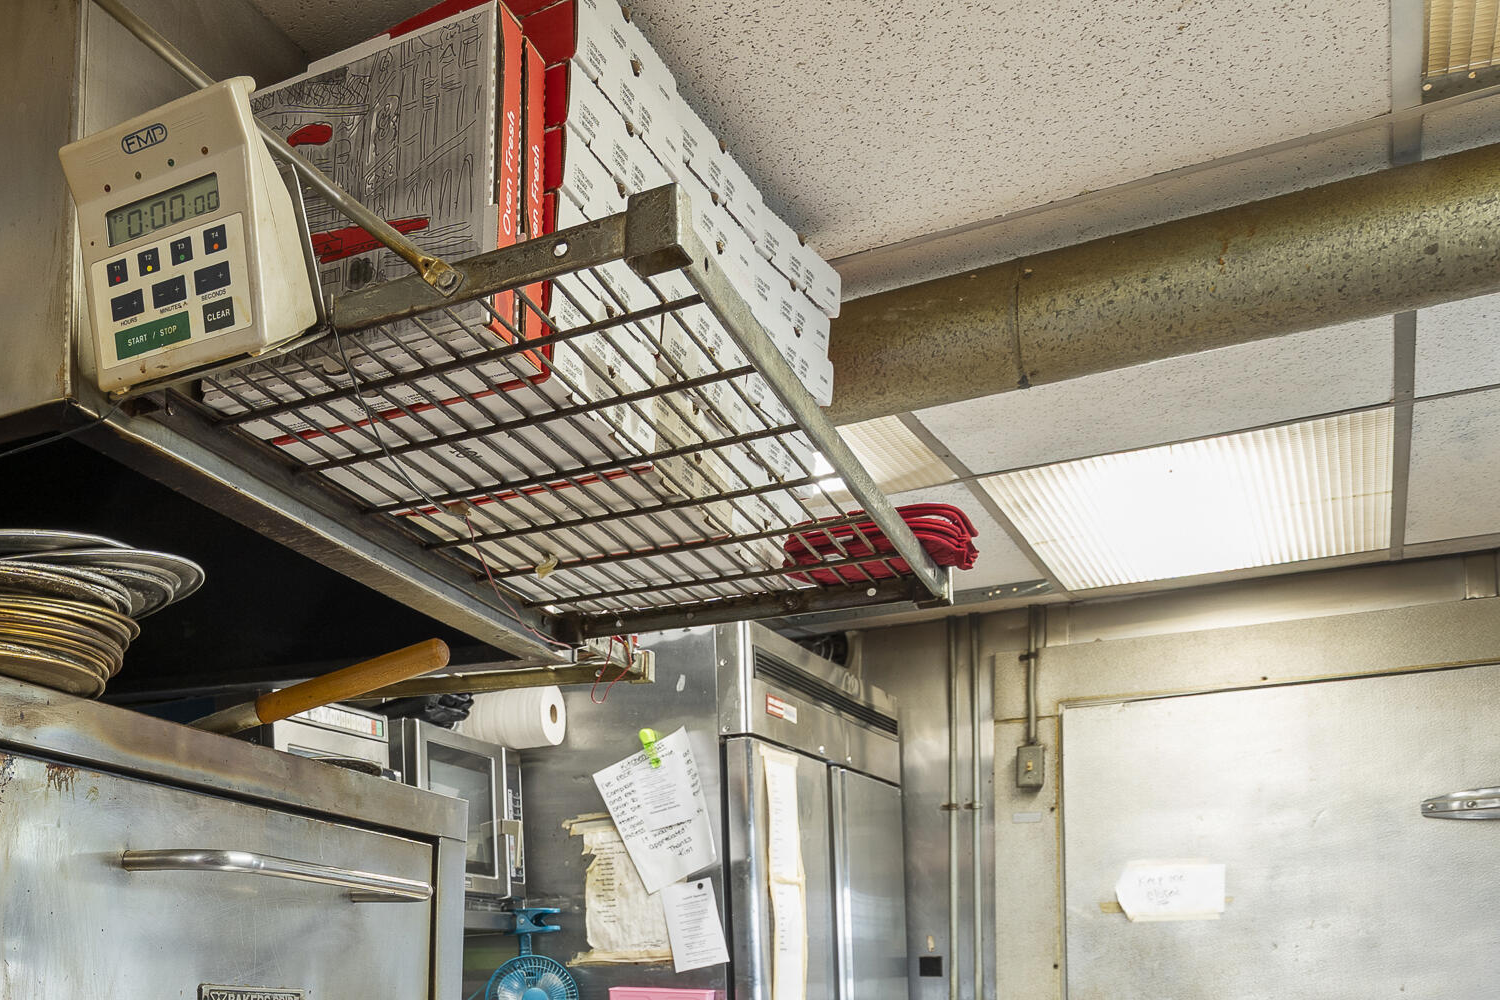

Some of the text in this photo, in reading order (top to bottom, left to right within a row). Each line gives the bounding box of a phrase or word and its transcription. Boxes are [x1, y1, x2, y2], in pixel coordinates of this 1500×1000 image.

[124, 125, 165, 153] FMP
[503, 111, 515, 236] Oven Fresh
[531, 144, 540, 205] Fresh
[211, 231, 219, 239] T4
[177, 242, 185, 250] T3
[201, 288, 227, 301] SECONDS
[160, 303, 181, 314] MINUTES
[206, 308, 231, 322] CLEAR
[120, 316, 138, 327] HOURS
[127, 333, 148, 346] START
[160, 324, 177, 337] STOP
